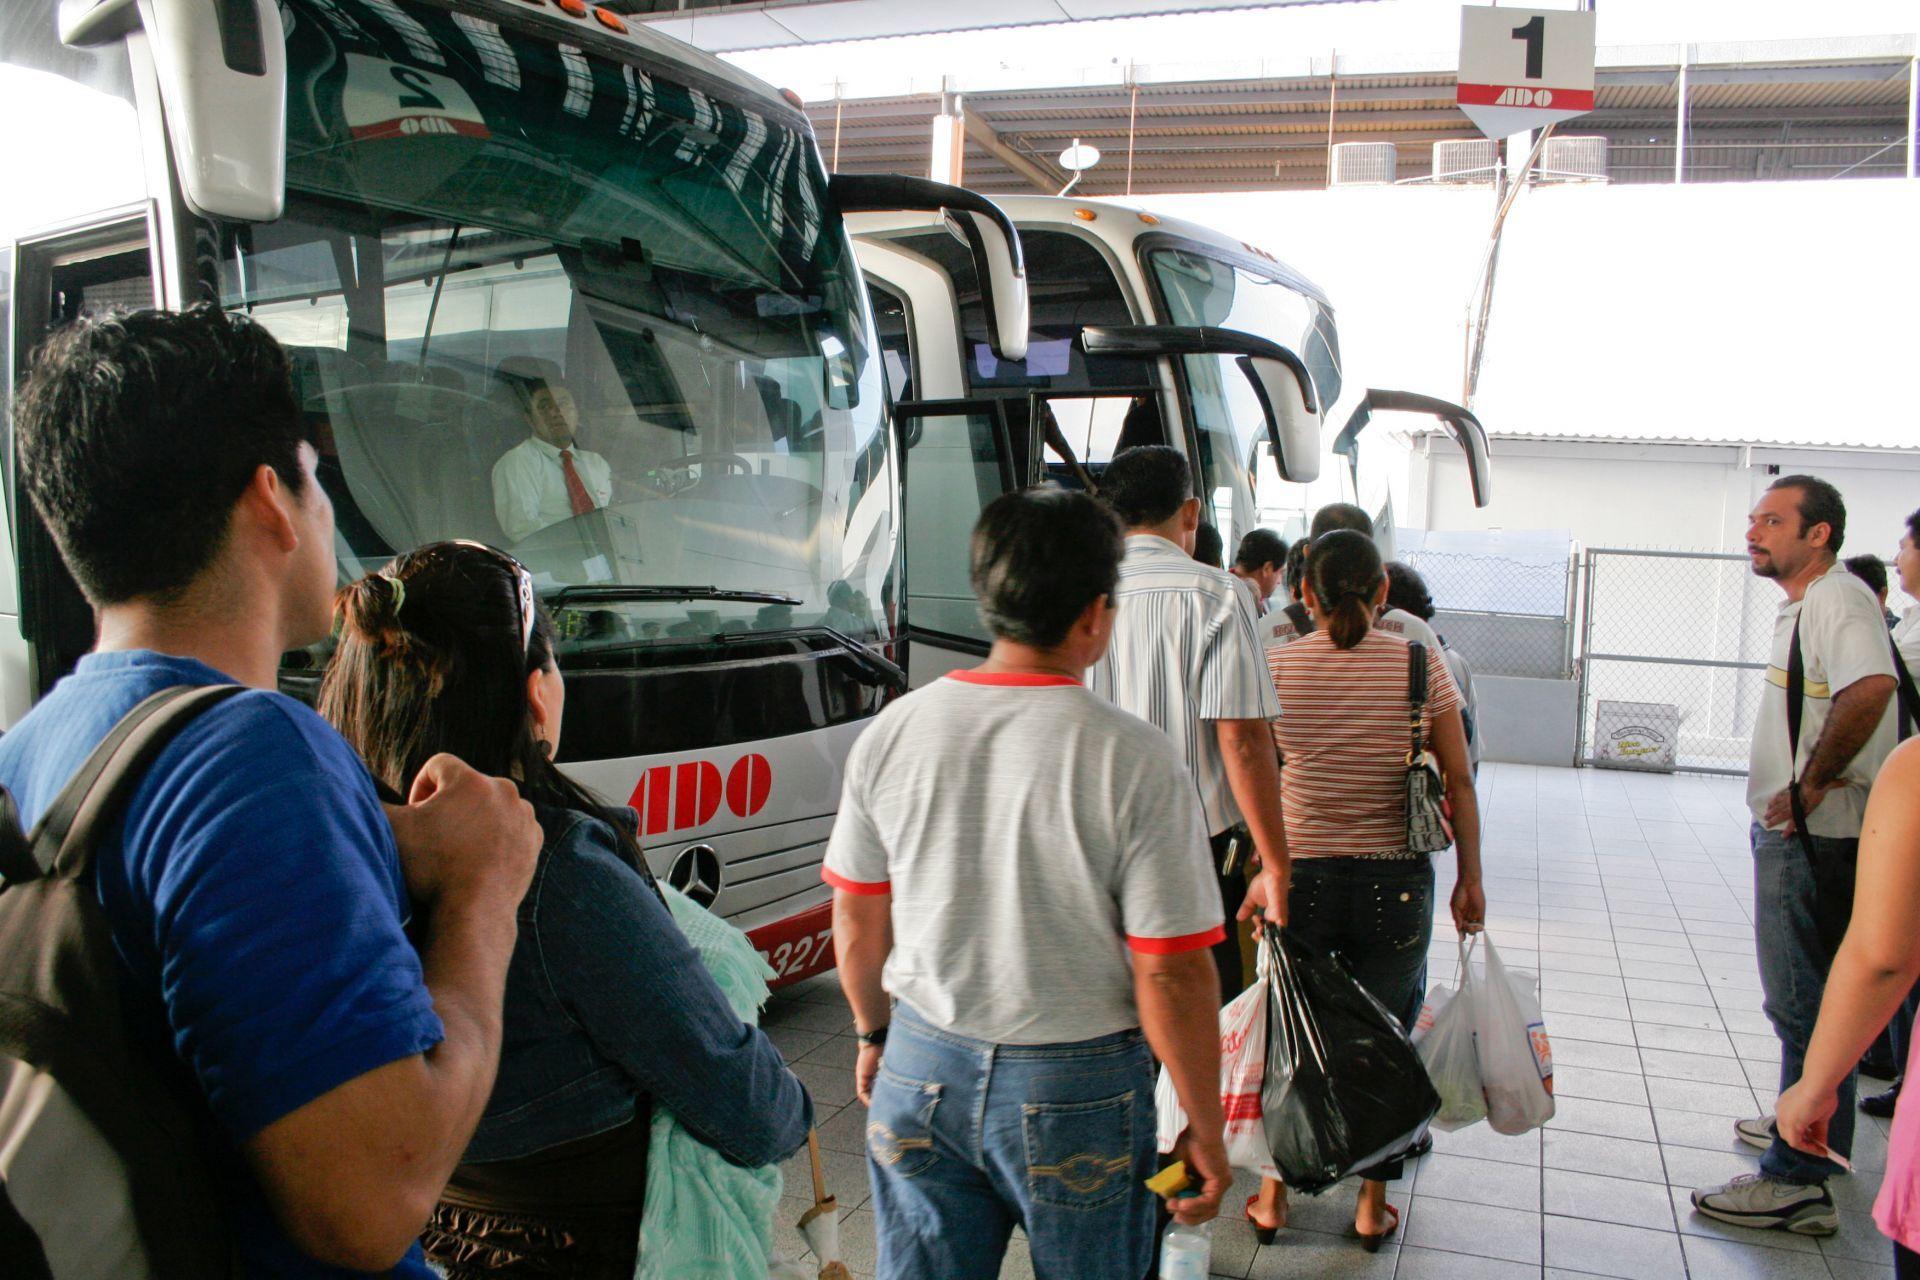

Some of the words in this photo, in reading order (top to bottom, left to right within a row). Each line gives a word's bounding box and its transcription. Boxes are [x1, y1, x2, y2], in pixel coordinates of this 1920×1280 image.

[1511, 15, 1545, 79] 1
[1494, 87, 1553, 107] ADO
[627, 753, 772, 838] ADO
[757, 928, 833, 978] 327
